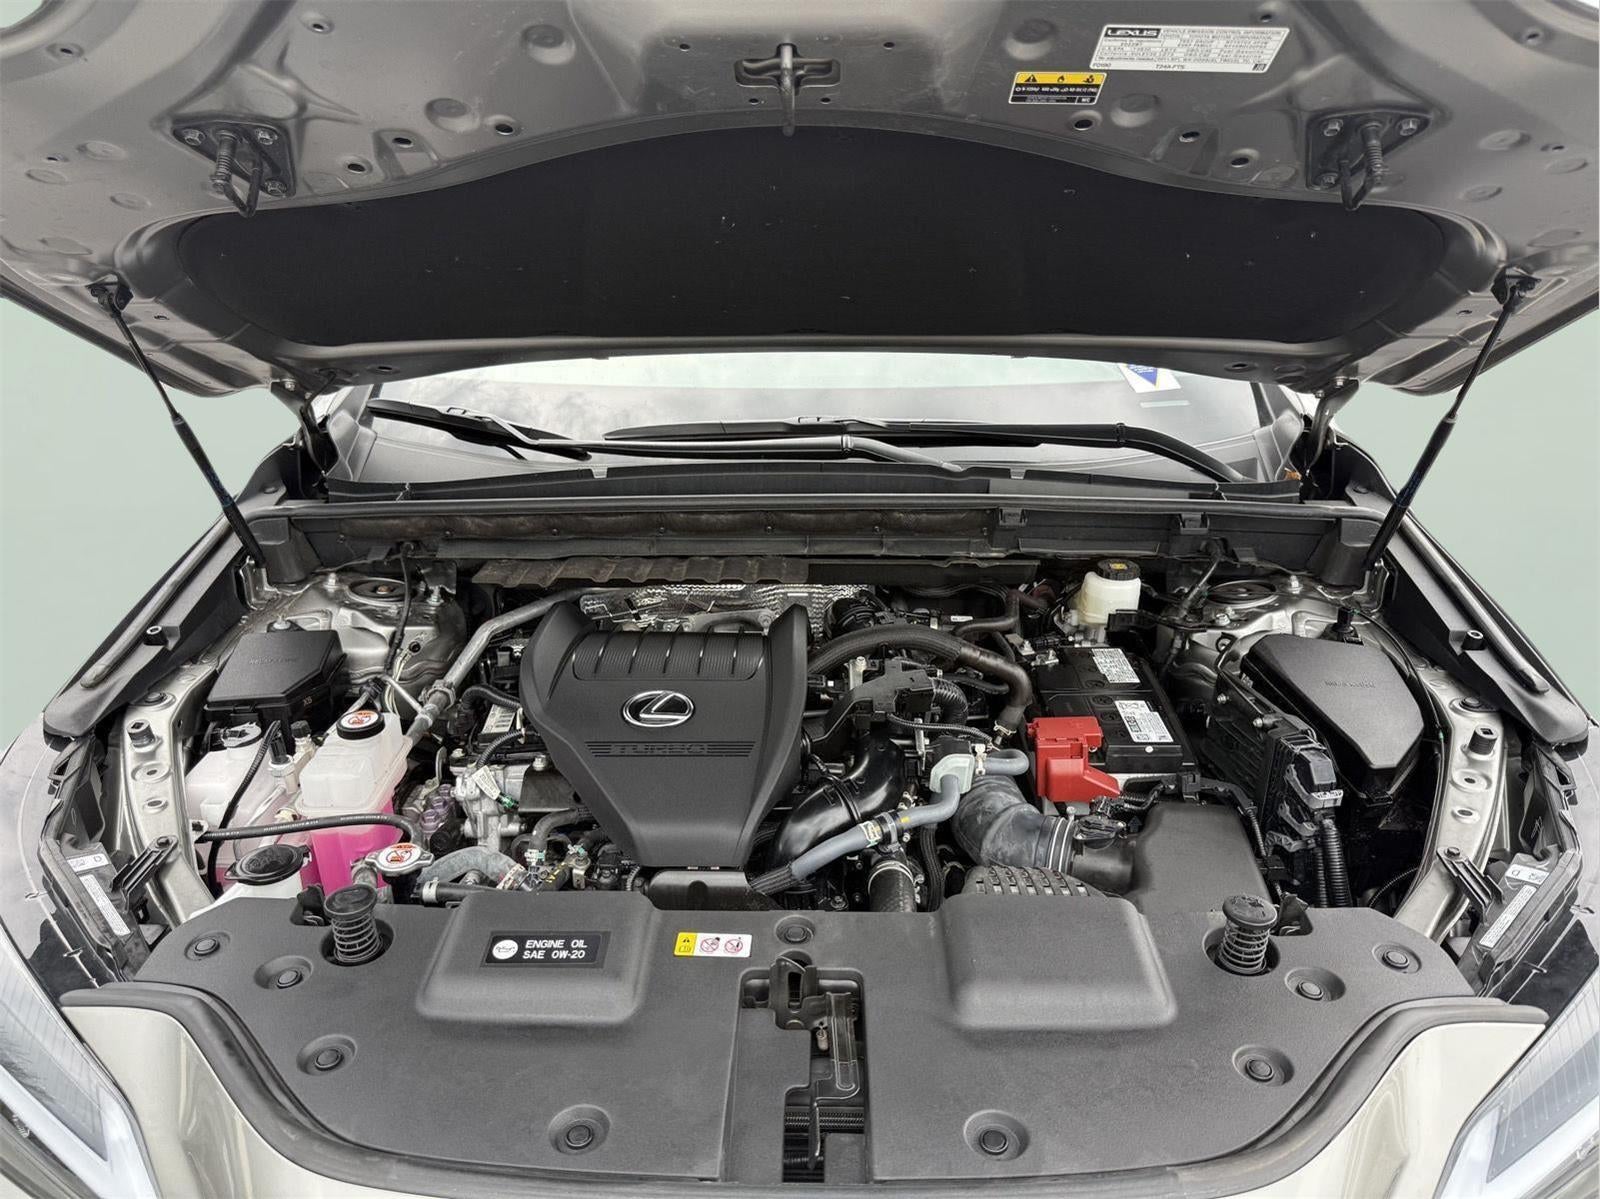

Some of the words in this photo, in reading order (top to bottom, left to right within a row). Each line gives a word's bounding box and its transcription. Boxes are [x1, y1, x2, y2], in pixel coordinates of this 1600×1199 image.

[1107, 29, 1157, 37] LEXUS
[525, 939, 565, 949] ENGINE
[571, 939, 588, 948] OIL
[522, 950, 546, 959] SAE
[551, 950, 586, 959] 0W-20
